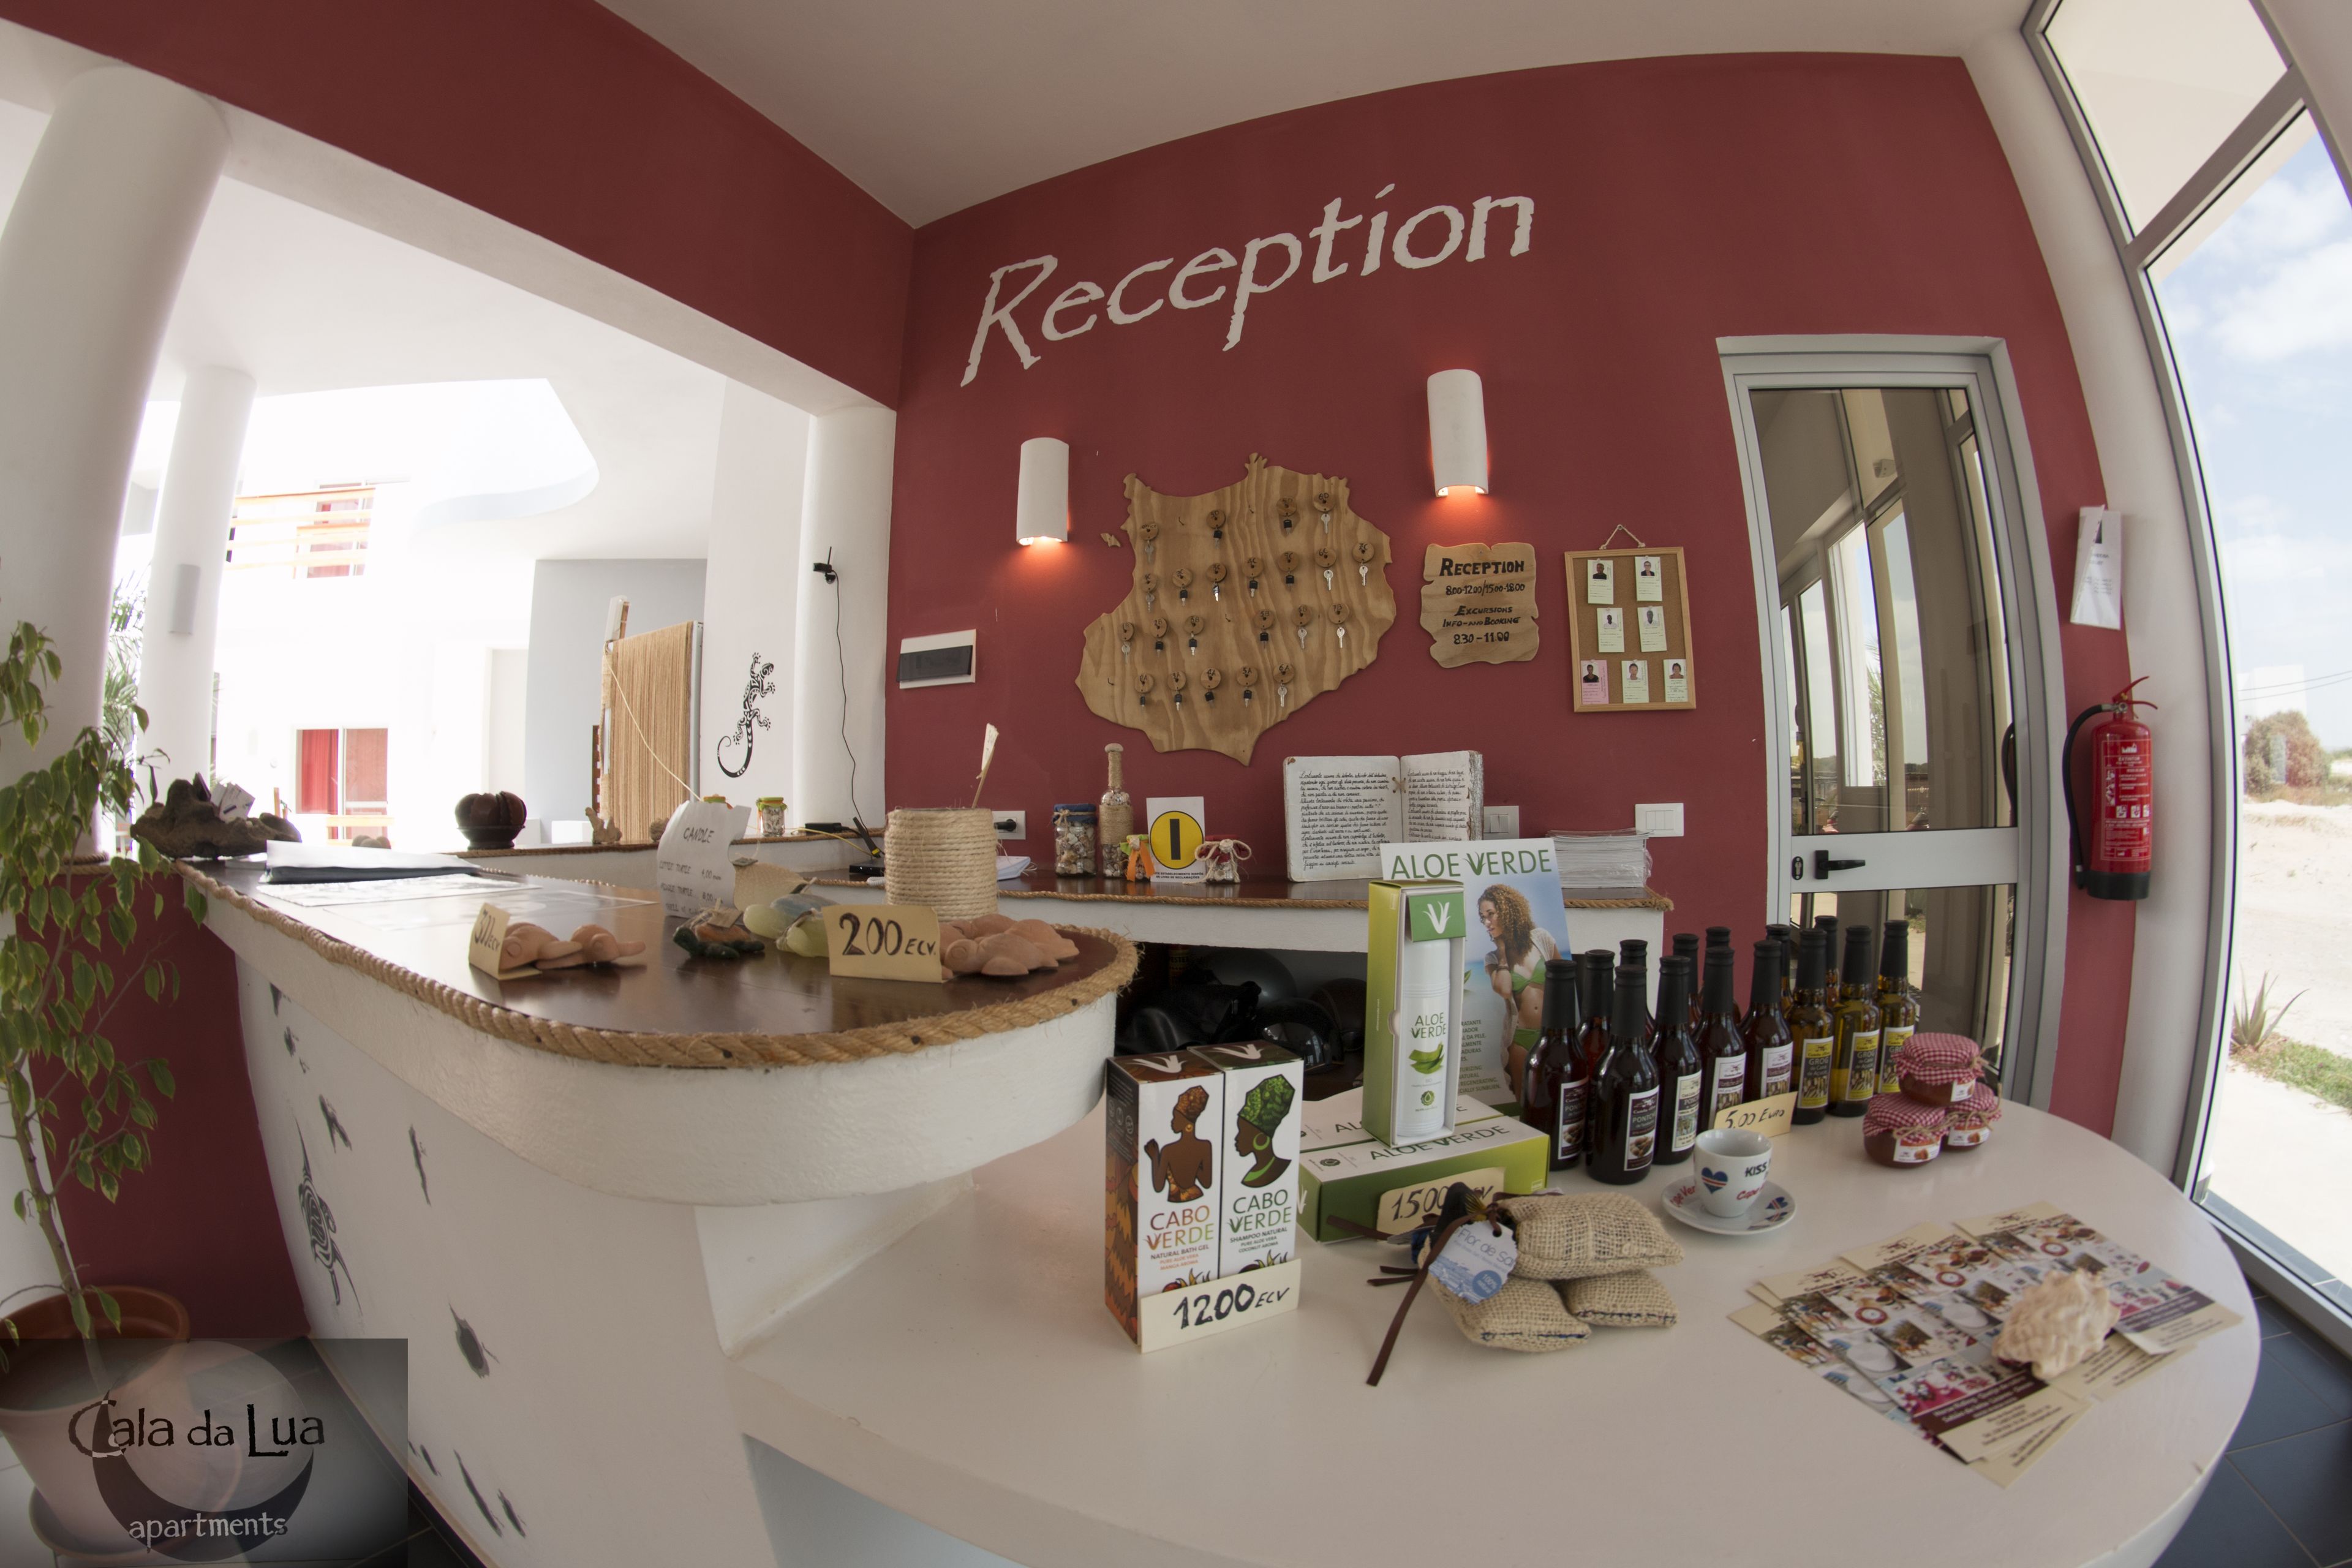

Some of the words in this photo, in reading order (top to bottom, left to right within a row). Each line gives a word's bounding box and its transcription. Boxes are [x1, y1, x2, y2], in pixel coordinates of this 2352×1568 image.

[960, 183, 1534, 387] Reception
[1439, 558, 1525, 576] RECEPTION
[1455, 605, 1513, 616] EXCURSIONS
[1484, 617, 1521, 625] BOOKING
[684, 827, 714, 843] CANDLE
[1391, 853, 1461, 880] ALOE
[1463, 849, 1553, 876] VERDE
[839, 911, 903, 957] 200
[1415, 1012, 1444, 1027] ALOE
[1411, 1023, 1447, 1039] VERDE
[1808, 1057, 1829, 1065] GROG
[1370, 1141, 1433, 1160] ALOE
[1436, 1125, 1510, 1147] VERDE
[1744, 1161, 1767, 1178] KISS
[1679, 1185, 1695, 1197] Ver
[1233, 1189, 1289, 1214] CABO
[1150, 1205, 1210, 1231] CABO
[1227, 1207, 1292, 1234] VERDE
[1146, 1223, 1214, 1250] VERDE
[1230, 1233, 1261, 1243] SHAMPOO
[1262, 1227, 1287, 1237] NATURAL
[1458, 1228, 1480, 1246] Flor
[1480, 1243, 1496, 1256] de
[1150, 1250, 1180, 1259] NATURAL
[1173, 1283, 1255, 1329] 1200
[1254, 1287, 1291, 1309] ECV
